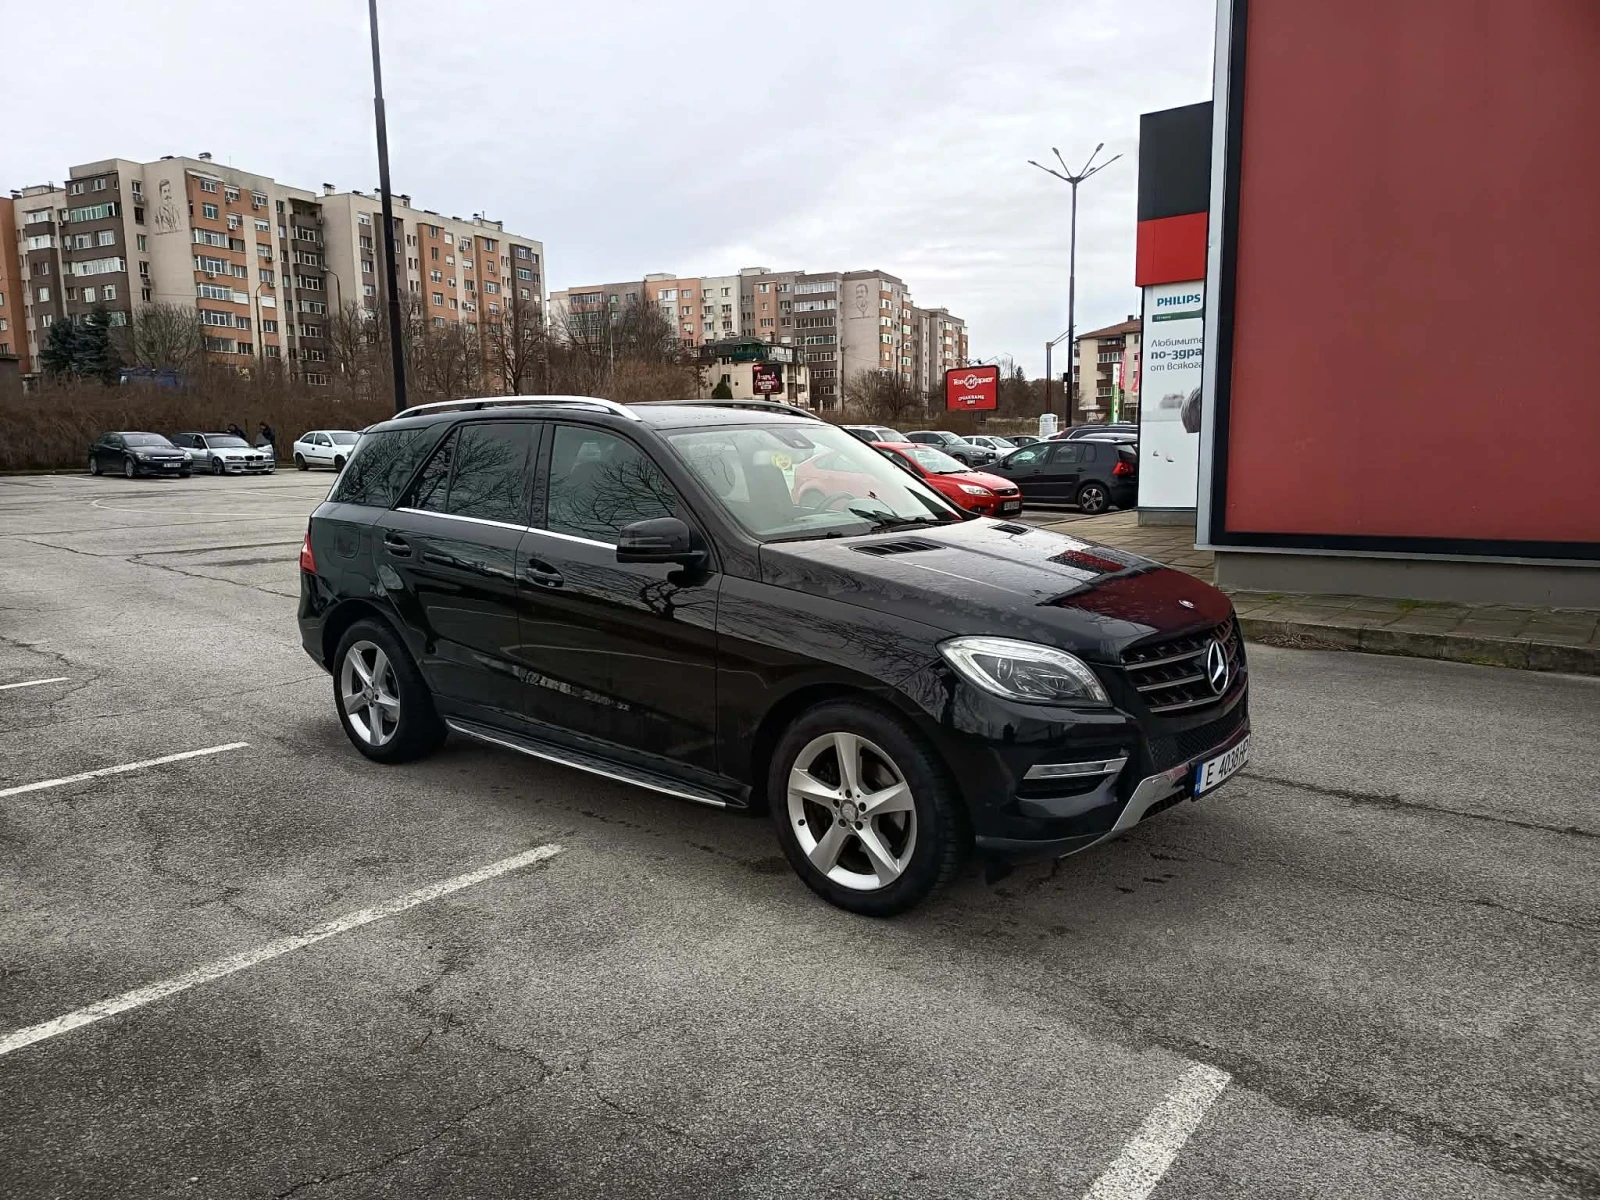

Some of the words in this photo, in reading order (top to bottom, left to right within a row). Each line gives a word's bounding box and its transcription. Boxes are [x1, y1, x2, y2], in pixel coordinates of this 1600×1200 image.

[1156, 293, 1201, 307] PHILIPS
[1150, 364, 1165, 372] от
[1206, 761, 1216, 787] E
